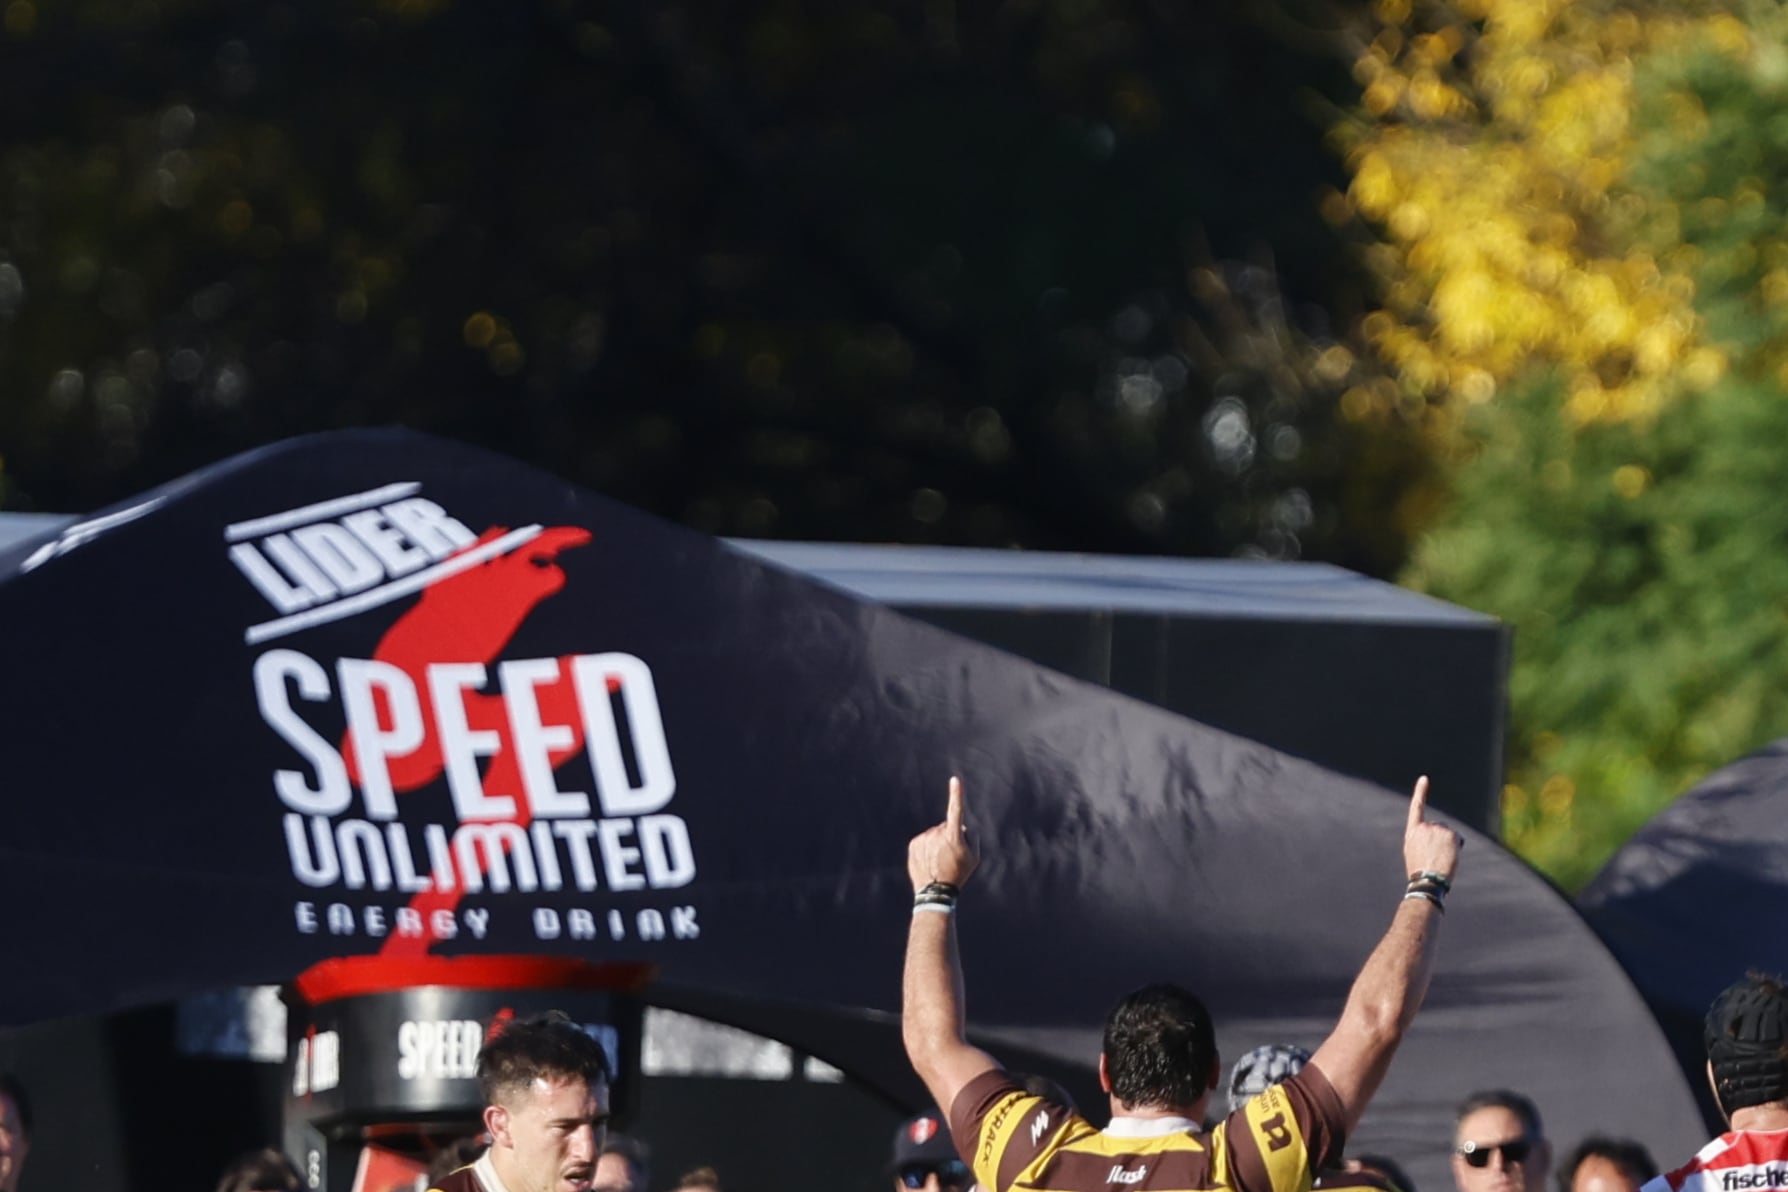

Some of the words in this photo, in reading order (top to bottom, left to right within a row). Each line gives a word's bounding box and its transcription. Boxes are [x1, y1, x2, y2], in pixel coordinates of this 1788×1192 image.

[229, 496, 479, 614] LIDER
[253, 648, 677, 820] SPEED
[283, 812, 696, 892] UNLIMITED
[296, 901, 490, 941] ENERGY
[533, 905, 701, 941] DRINK
[399, 1019, 483, 1080] SPEED
